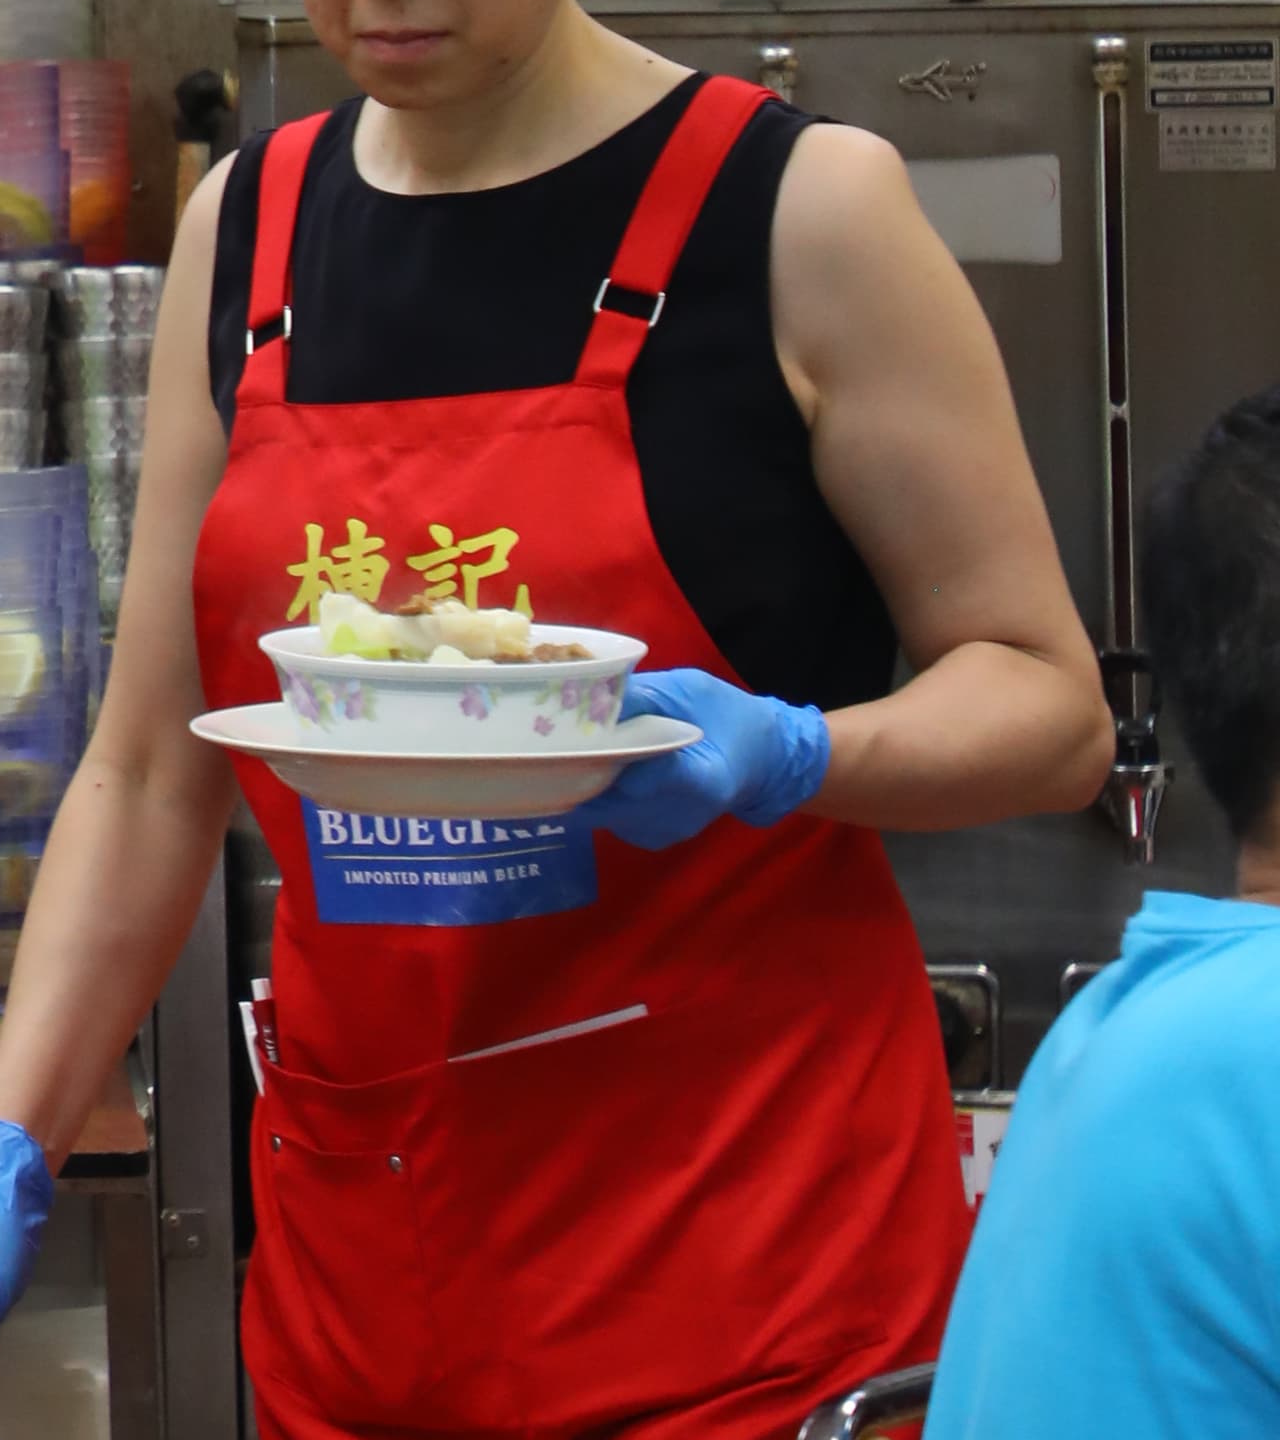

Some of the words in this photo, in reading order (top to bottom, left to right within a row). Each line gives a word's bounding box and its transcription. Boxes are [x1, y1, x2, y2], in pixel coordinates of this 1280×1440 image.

[285, 518, 535, 624] 棟記
[316, 810, 435, 846] BLUE
[344, 870, 420, 886] IMPORTED
[423, 870, 488, 885] PREMIUM
[494, 863, 542, 882] BEER
